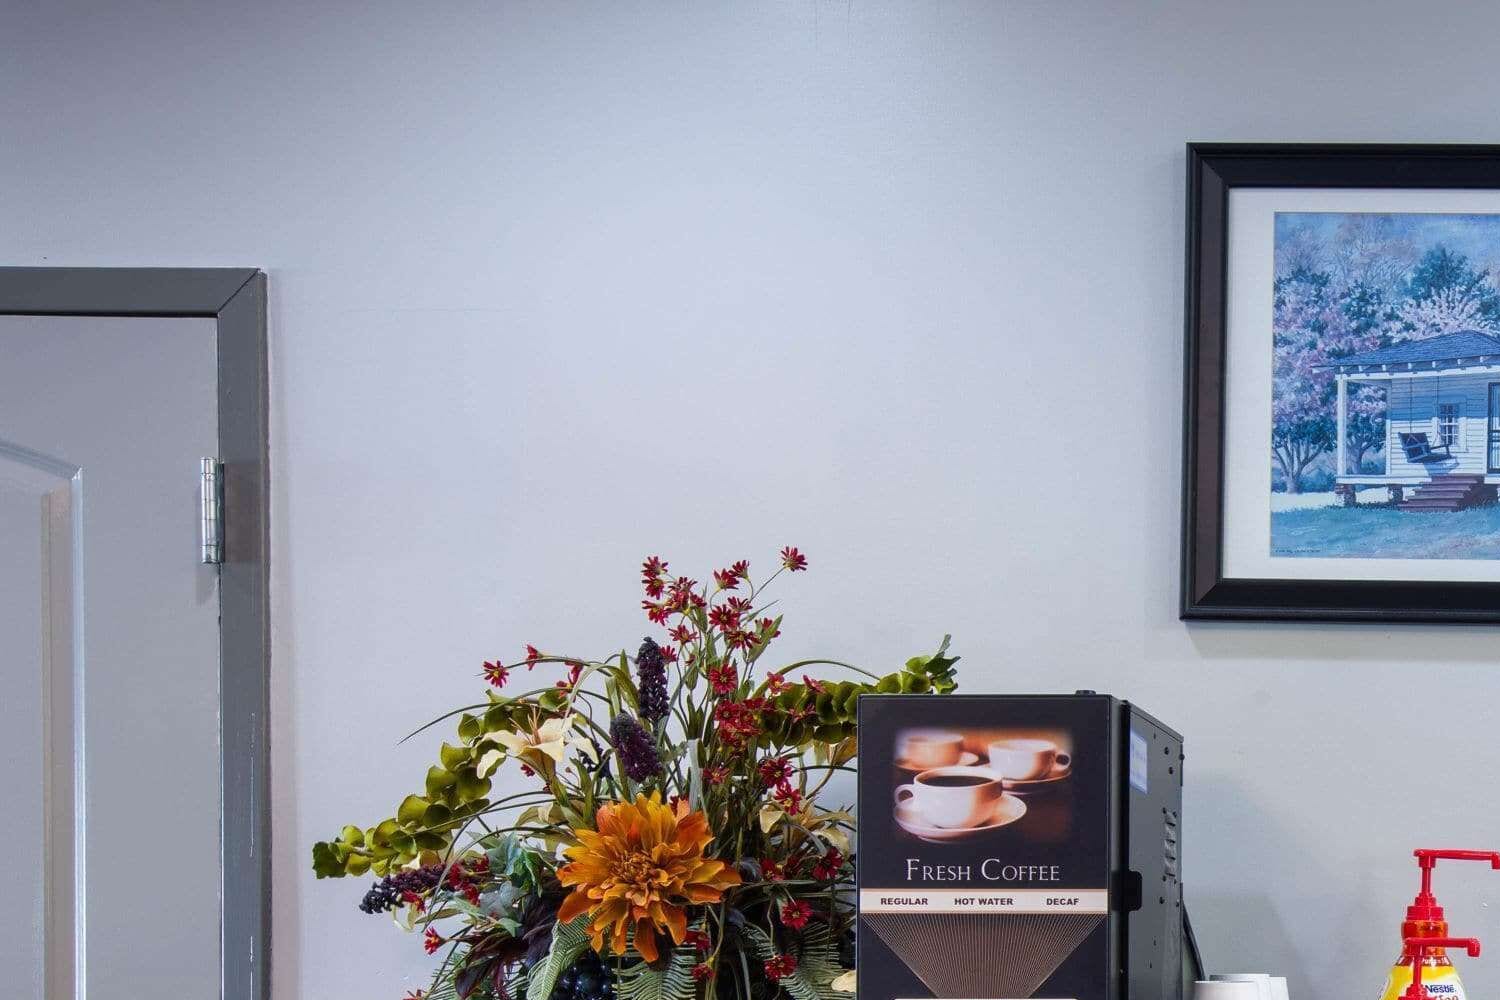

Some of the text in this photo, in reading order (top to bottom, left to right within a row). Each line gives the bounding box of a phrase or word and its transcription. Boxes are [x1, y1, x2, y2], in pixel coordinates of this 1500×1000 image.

[906, 858, 1060, 881] FRESH COFFEE
[880, 897, 929, 906] REGULAR
[954, 897, 1014, 906] HOT WATER
[1046, 897, 1079, 906] DECAF
